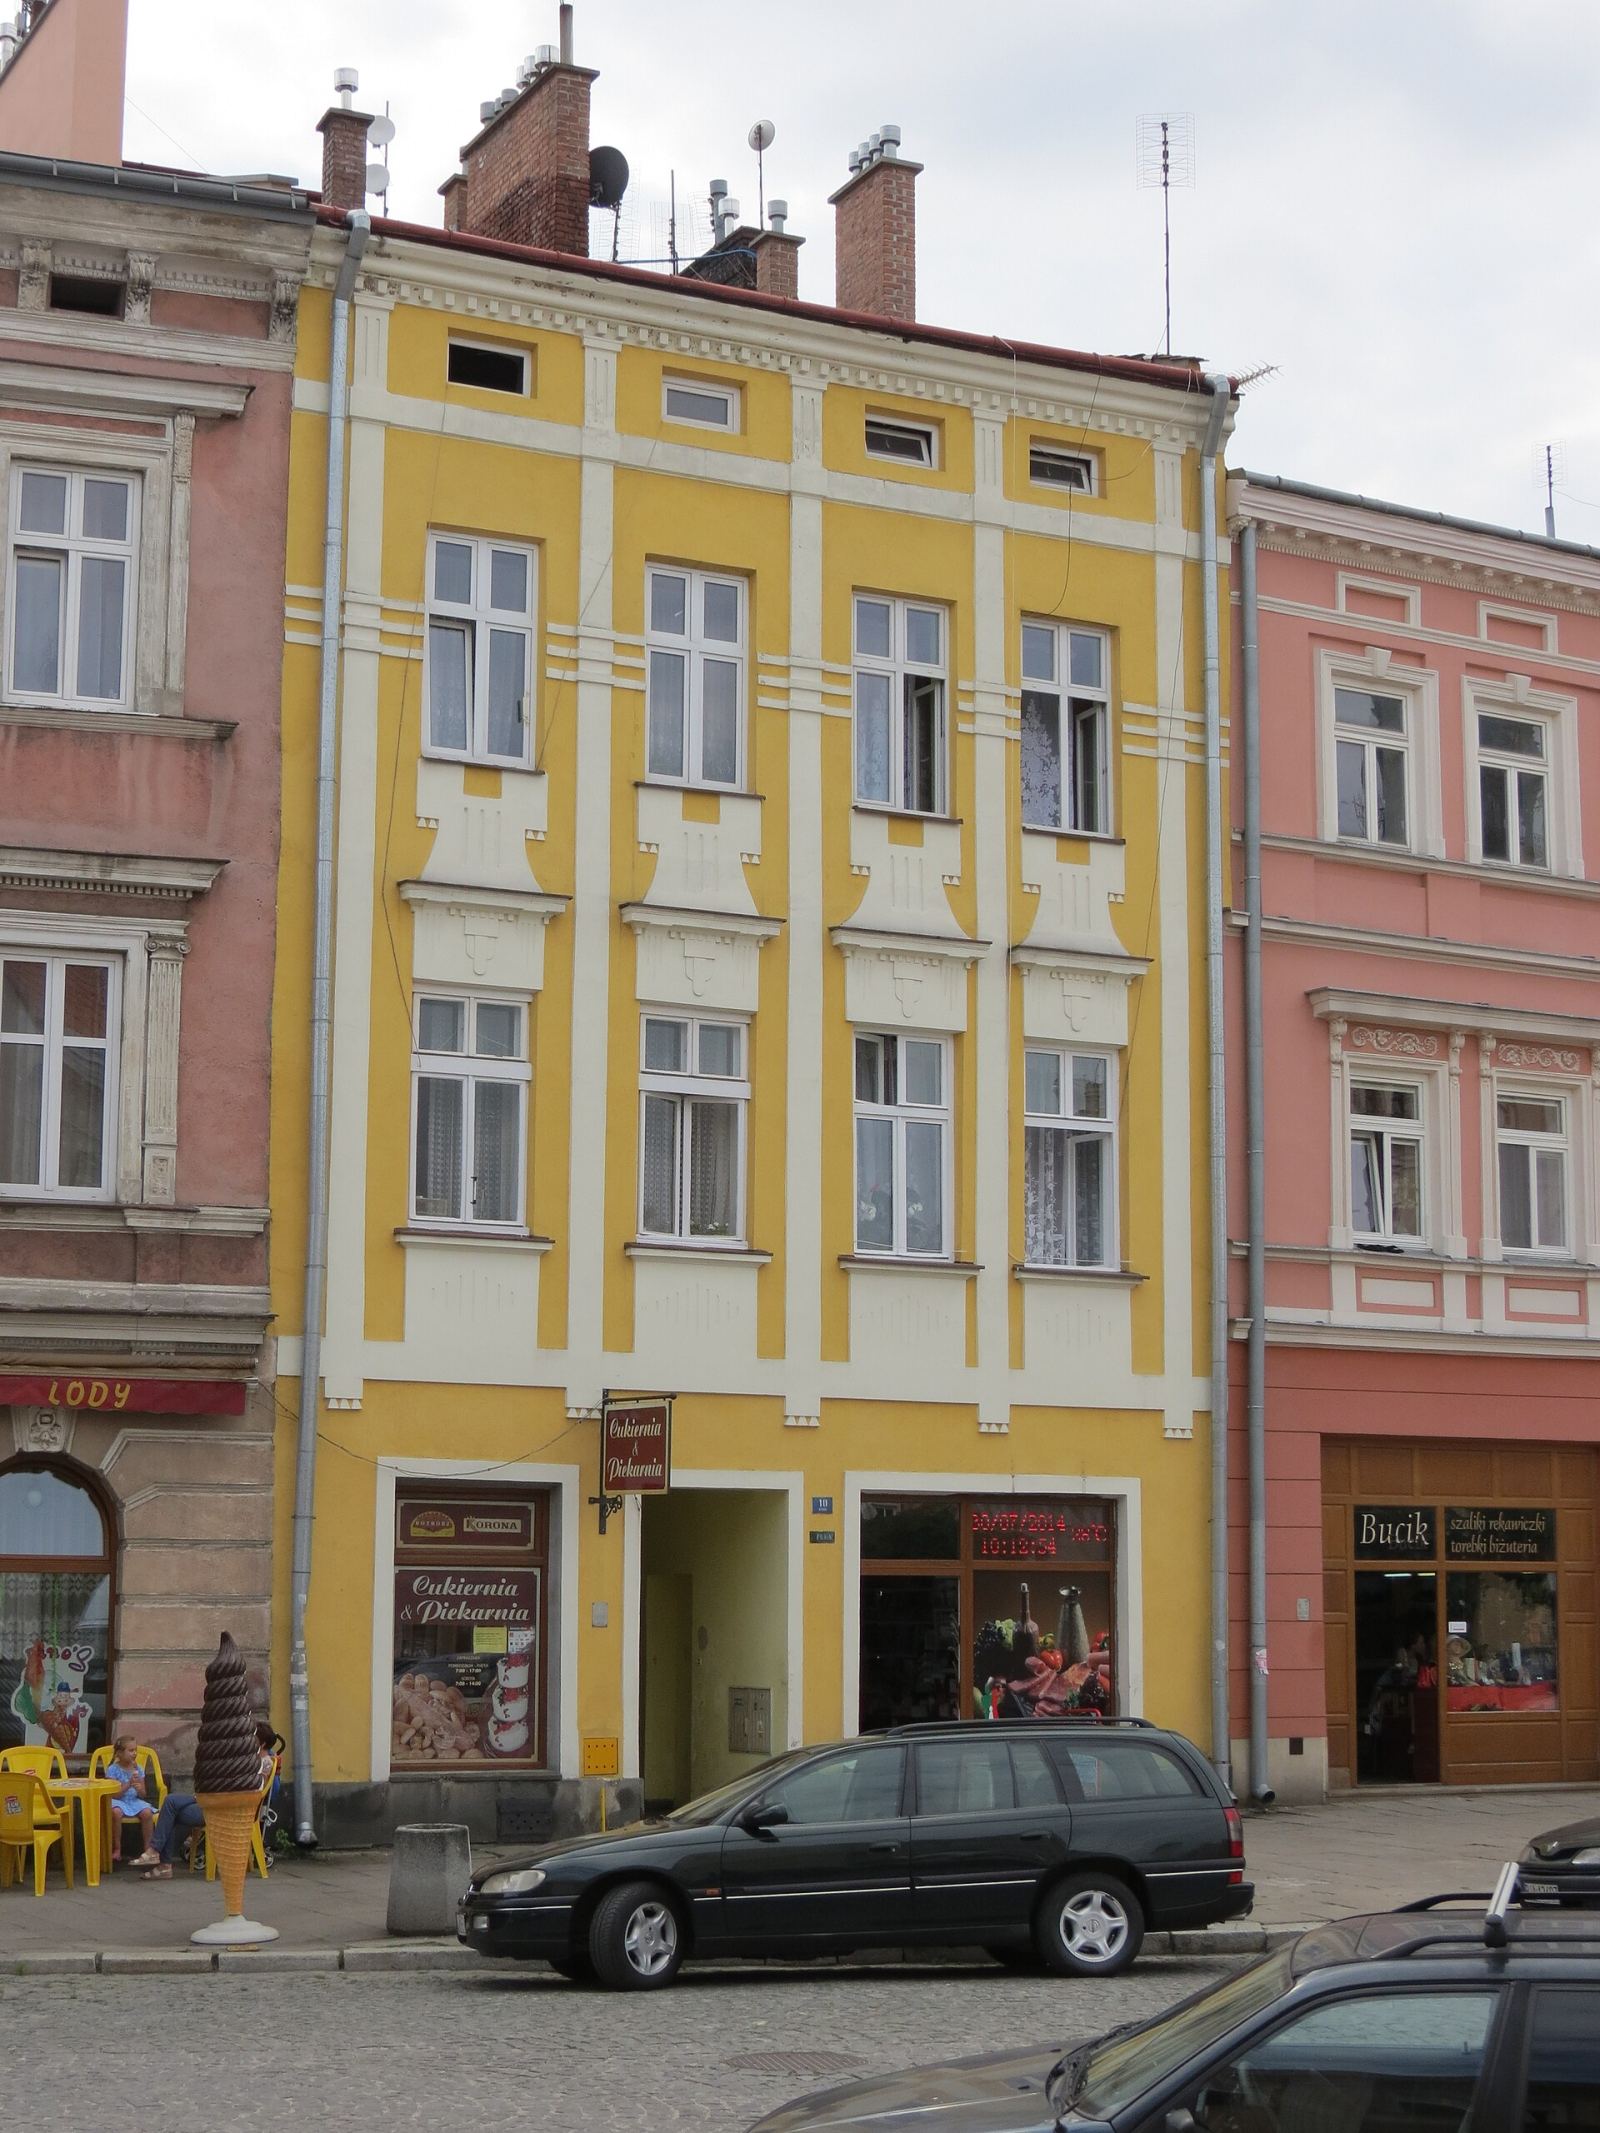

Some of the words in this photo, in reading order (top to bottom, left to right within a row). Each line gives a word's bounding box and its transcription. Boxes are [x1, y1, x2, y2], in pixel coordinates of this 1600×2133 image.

[48, 1381, 131, 1408] LODY
[610, 1417, 662, 1438] Cukiernia
[608, 1457, 662, 1481] Piekarnia
[819, 1499, 828, 1507] 10
[466, 1518, 518, 1531] KORONA
[1360, 1511, 1429, 1544] Bucik
[1450, 1512, 1485, 1531] szaliki
[1450, 1535, 1486, 1554] torebki
[1489, 1535, 1538, 1554] biżuteria
[412, 1575, 519, 1596] Cukiernia
[400, 1604, 412, 1620] &
[416, 1600, 530, 1624] Piekarnia
